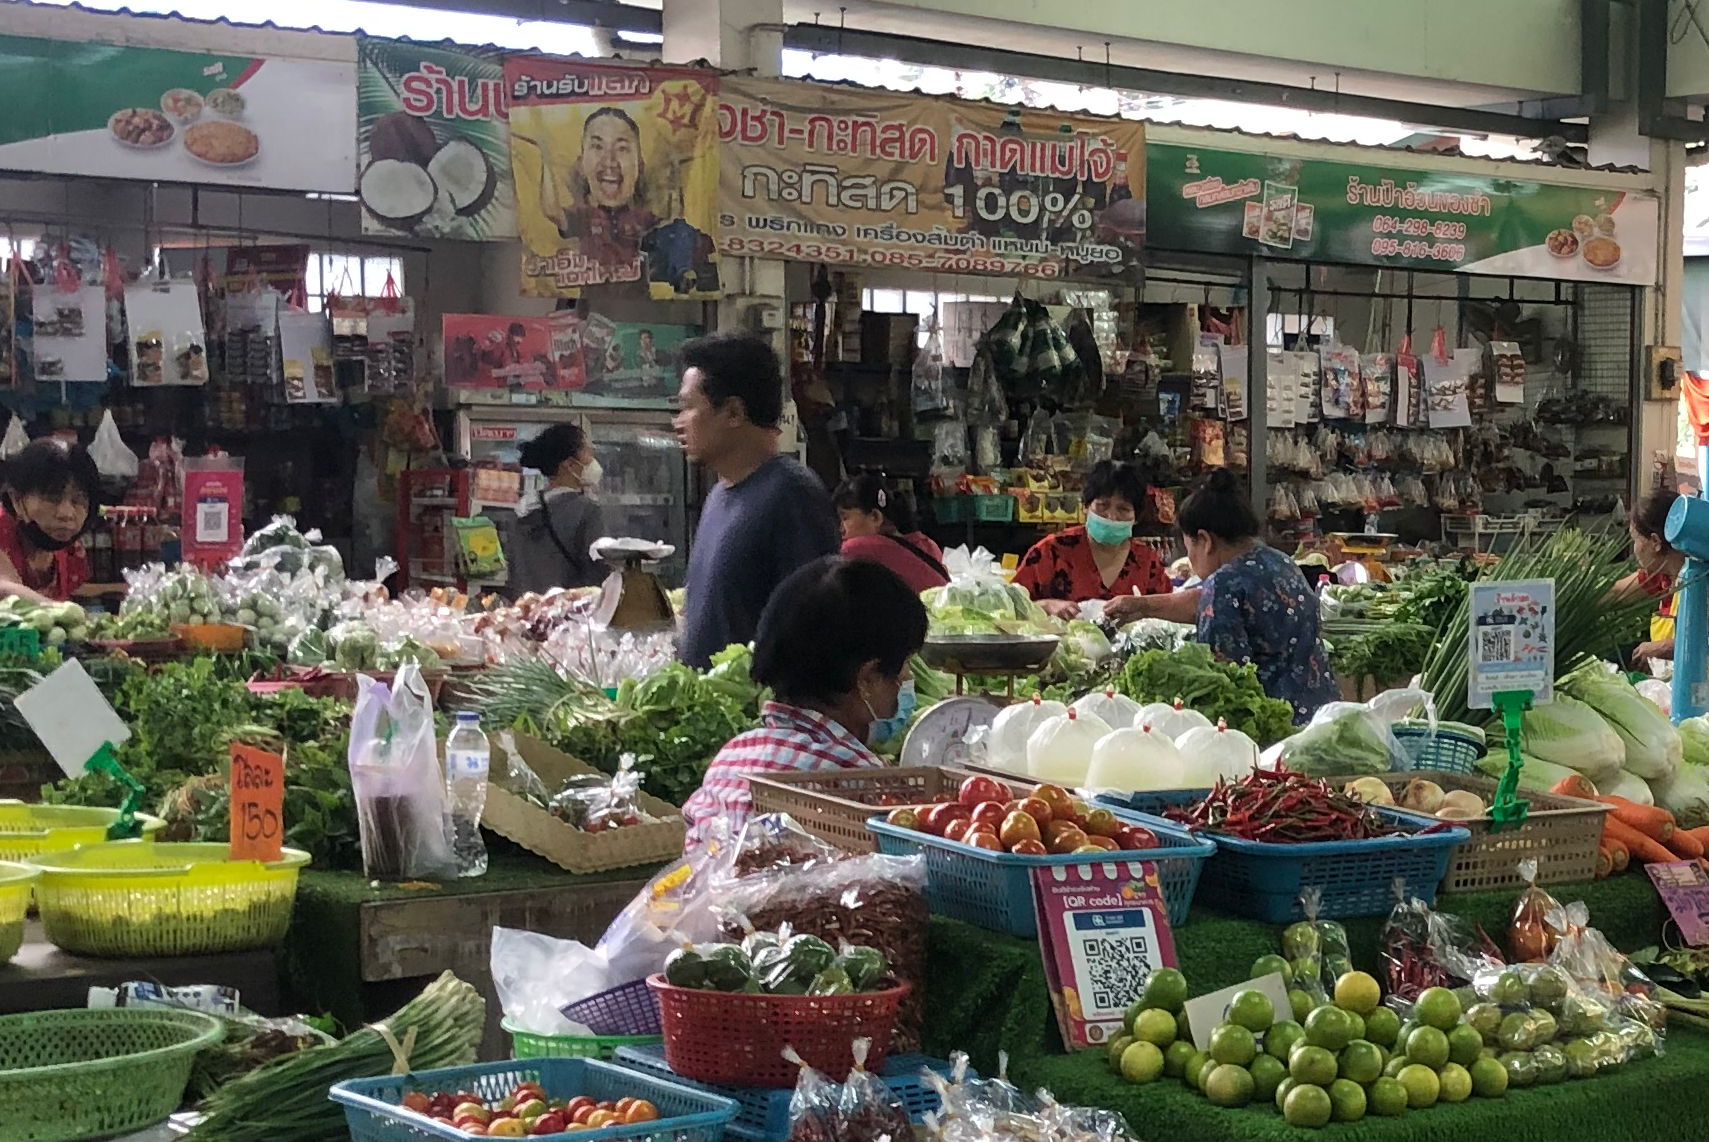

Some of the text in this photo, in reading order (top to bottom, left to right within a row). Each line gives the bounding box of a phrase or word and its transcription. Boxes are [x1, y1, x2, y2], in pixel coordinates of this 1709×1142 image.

[742, 163, 1093, 228] กะทิสด 100%
[241, 801, 279, 841] 150
